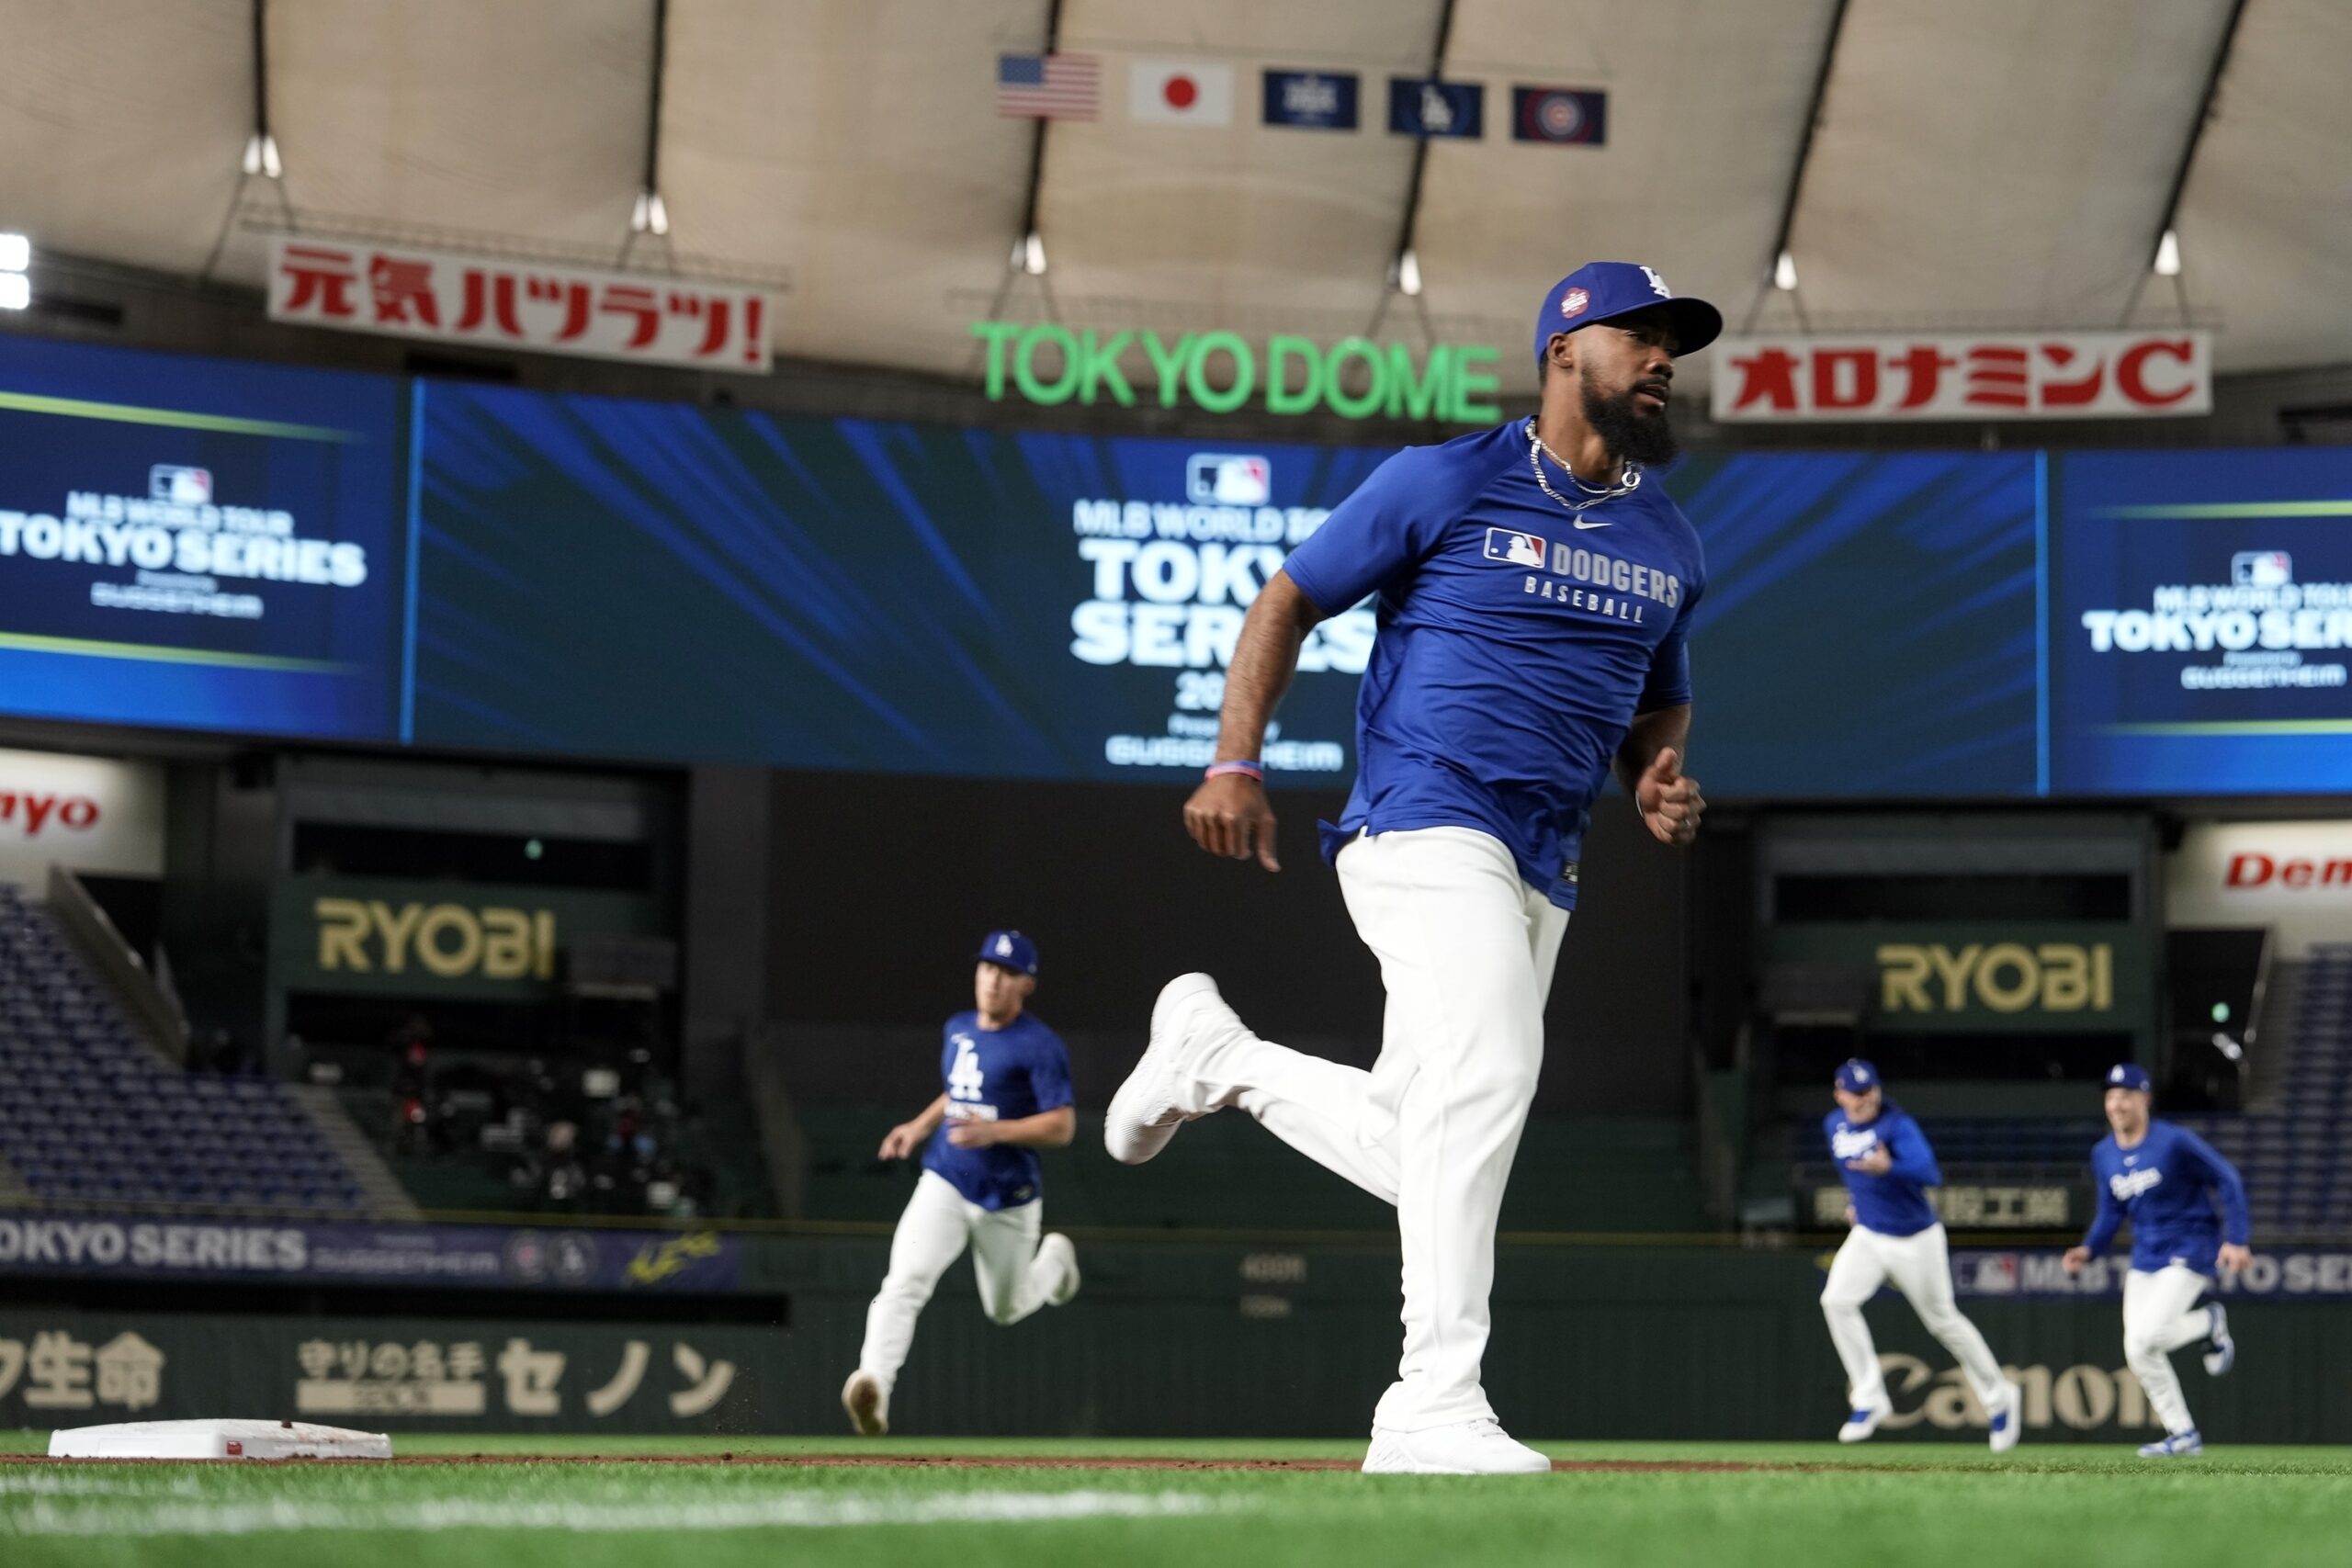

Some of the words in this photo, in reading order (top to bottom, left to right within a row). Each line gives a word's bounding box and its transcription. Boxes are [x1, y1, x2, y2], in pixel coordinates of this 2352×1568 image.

[279, 244, 763, 364] 元気ハツラツ!
[970, 321, 1255, 414] TOKYO
[1265, 334, 1502, 423] DOME
[1727, 338, 2198, 413] オロナミンC
[0, 510, 173, 570] TOKYO
[174, 527, 368, 588] SERIES
[1073, 500, 1151, 538] MLB
[1153, 503, 1285, 543] WORLD
[1523, 576, 1643, 624] BASEBALL
[1552, 542, 1679, 608] DODGERS
[1069, 598, 1377, 673] SERES
[2081, 609, 2258, 652] TOKYO
[2259, 608, 2352, 649] SER
[315, 897, 557, 979] RYOBI
[1875, 942, 2112, 1012] RYOBI
[130, 1224, 309, 1271] SERIES
